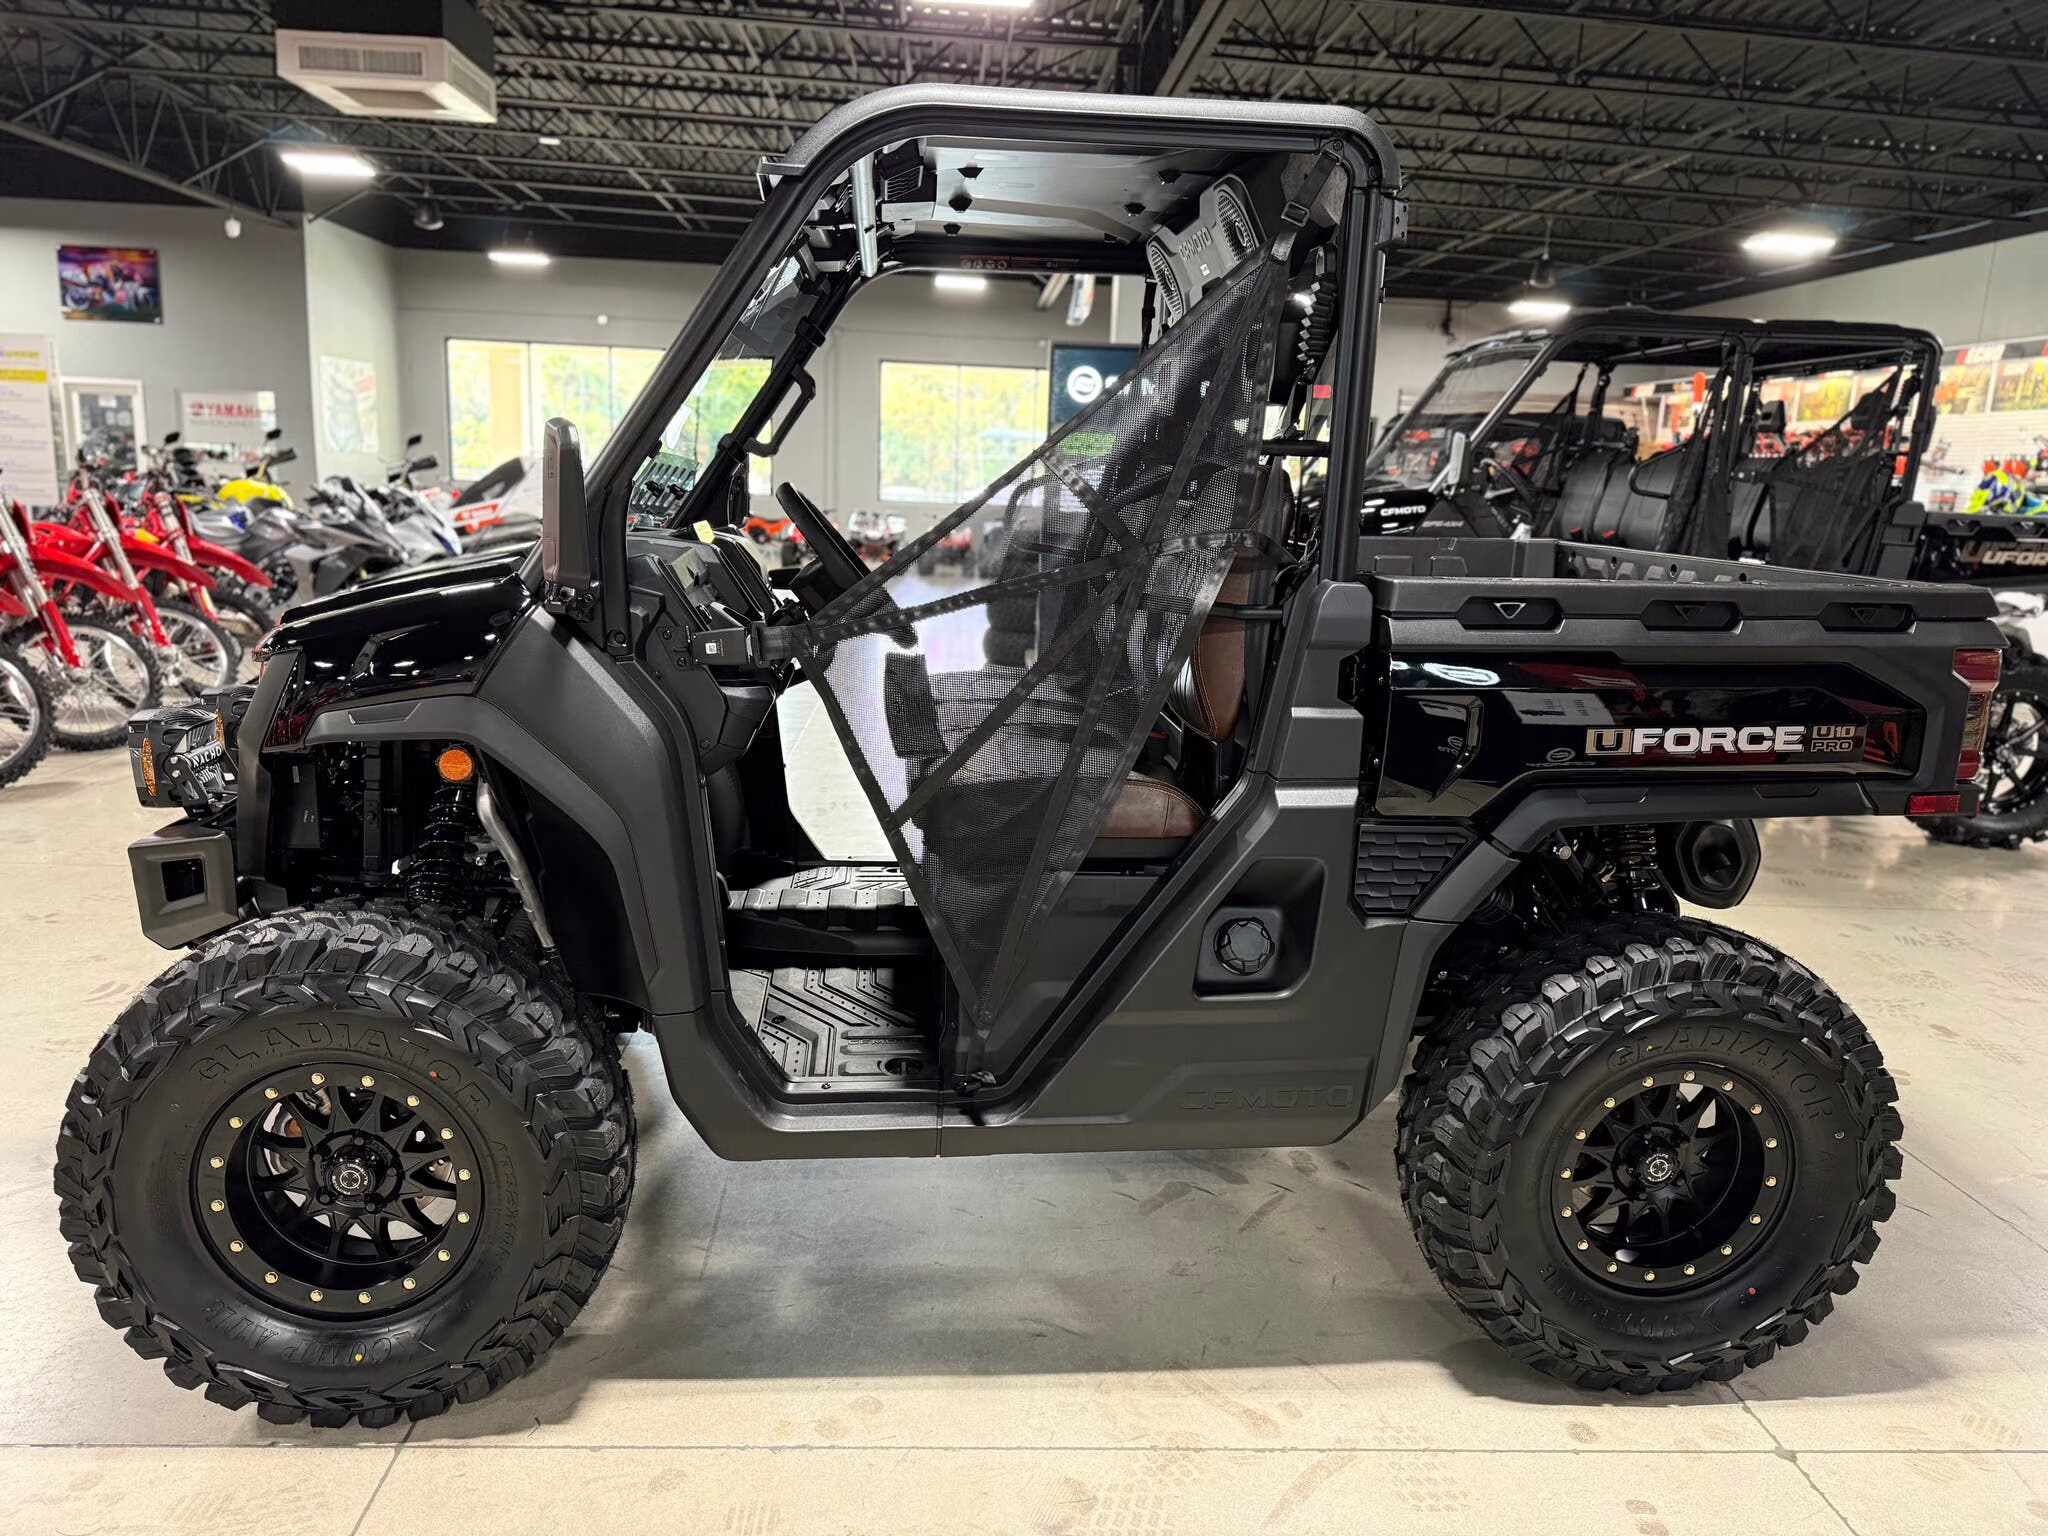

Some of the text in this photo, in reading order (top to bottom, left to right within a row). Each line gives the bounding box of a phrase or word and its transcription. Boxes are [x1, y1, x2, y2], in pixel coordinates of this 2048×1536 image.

[1380, 505, 1426, 516] CFMOTO
[1585, 726, 1806, 755] UFORCE
[1812, 725, 1856, 738] U10
[192, 745, 222, 768] NACHO
[1810, 739, 1853, 752] PRO
[189, 1022, 491, 1113] GLADIATOR
[1606, 1024, 1834, 1120] GLADIATOR
[1181, 1085, 1353, 1111] CFMOTO
